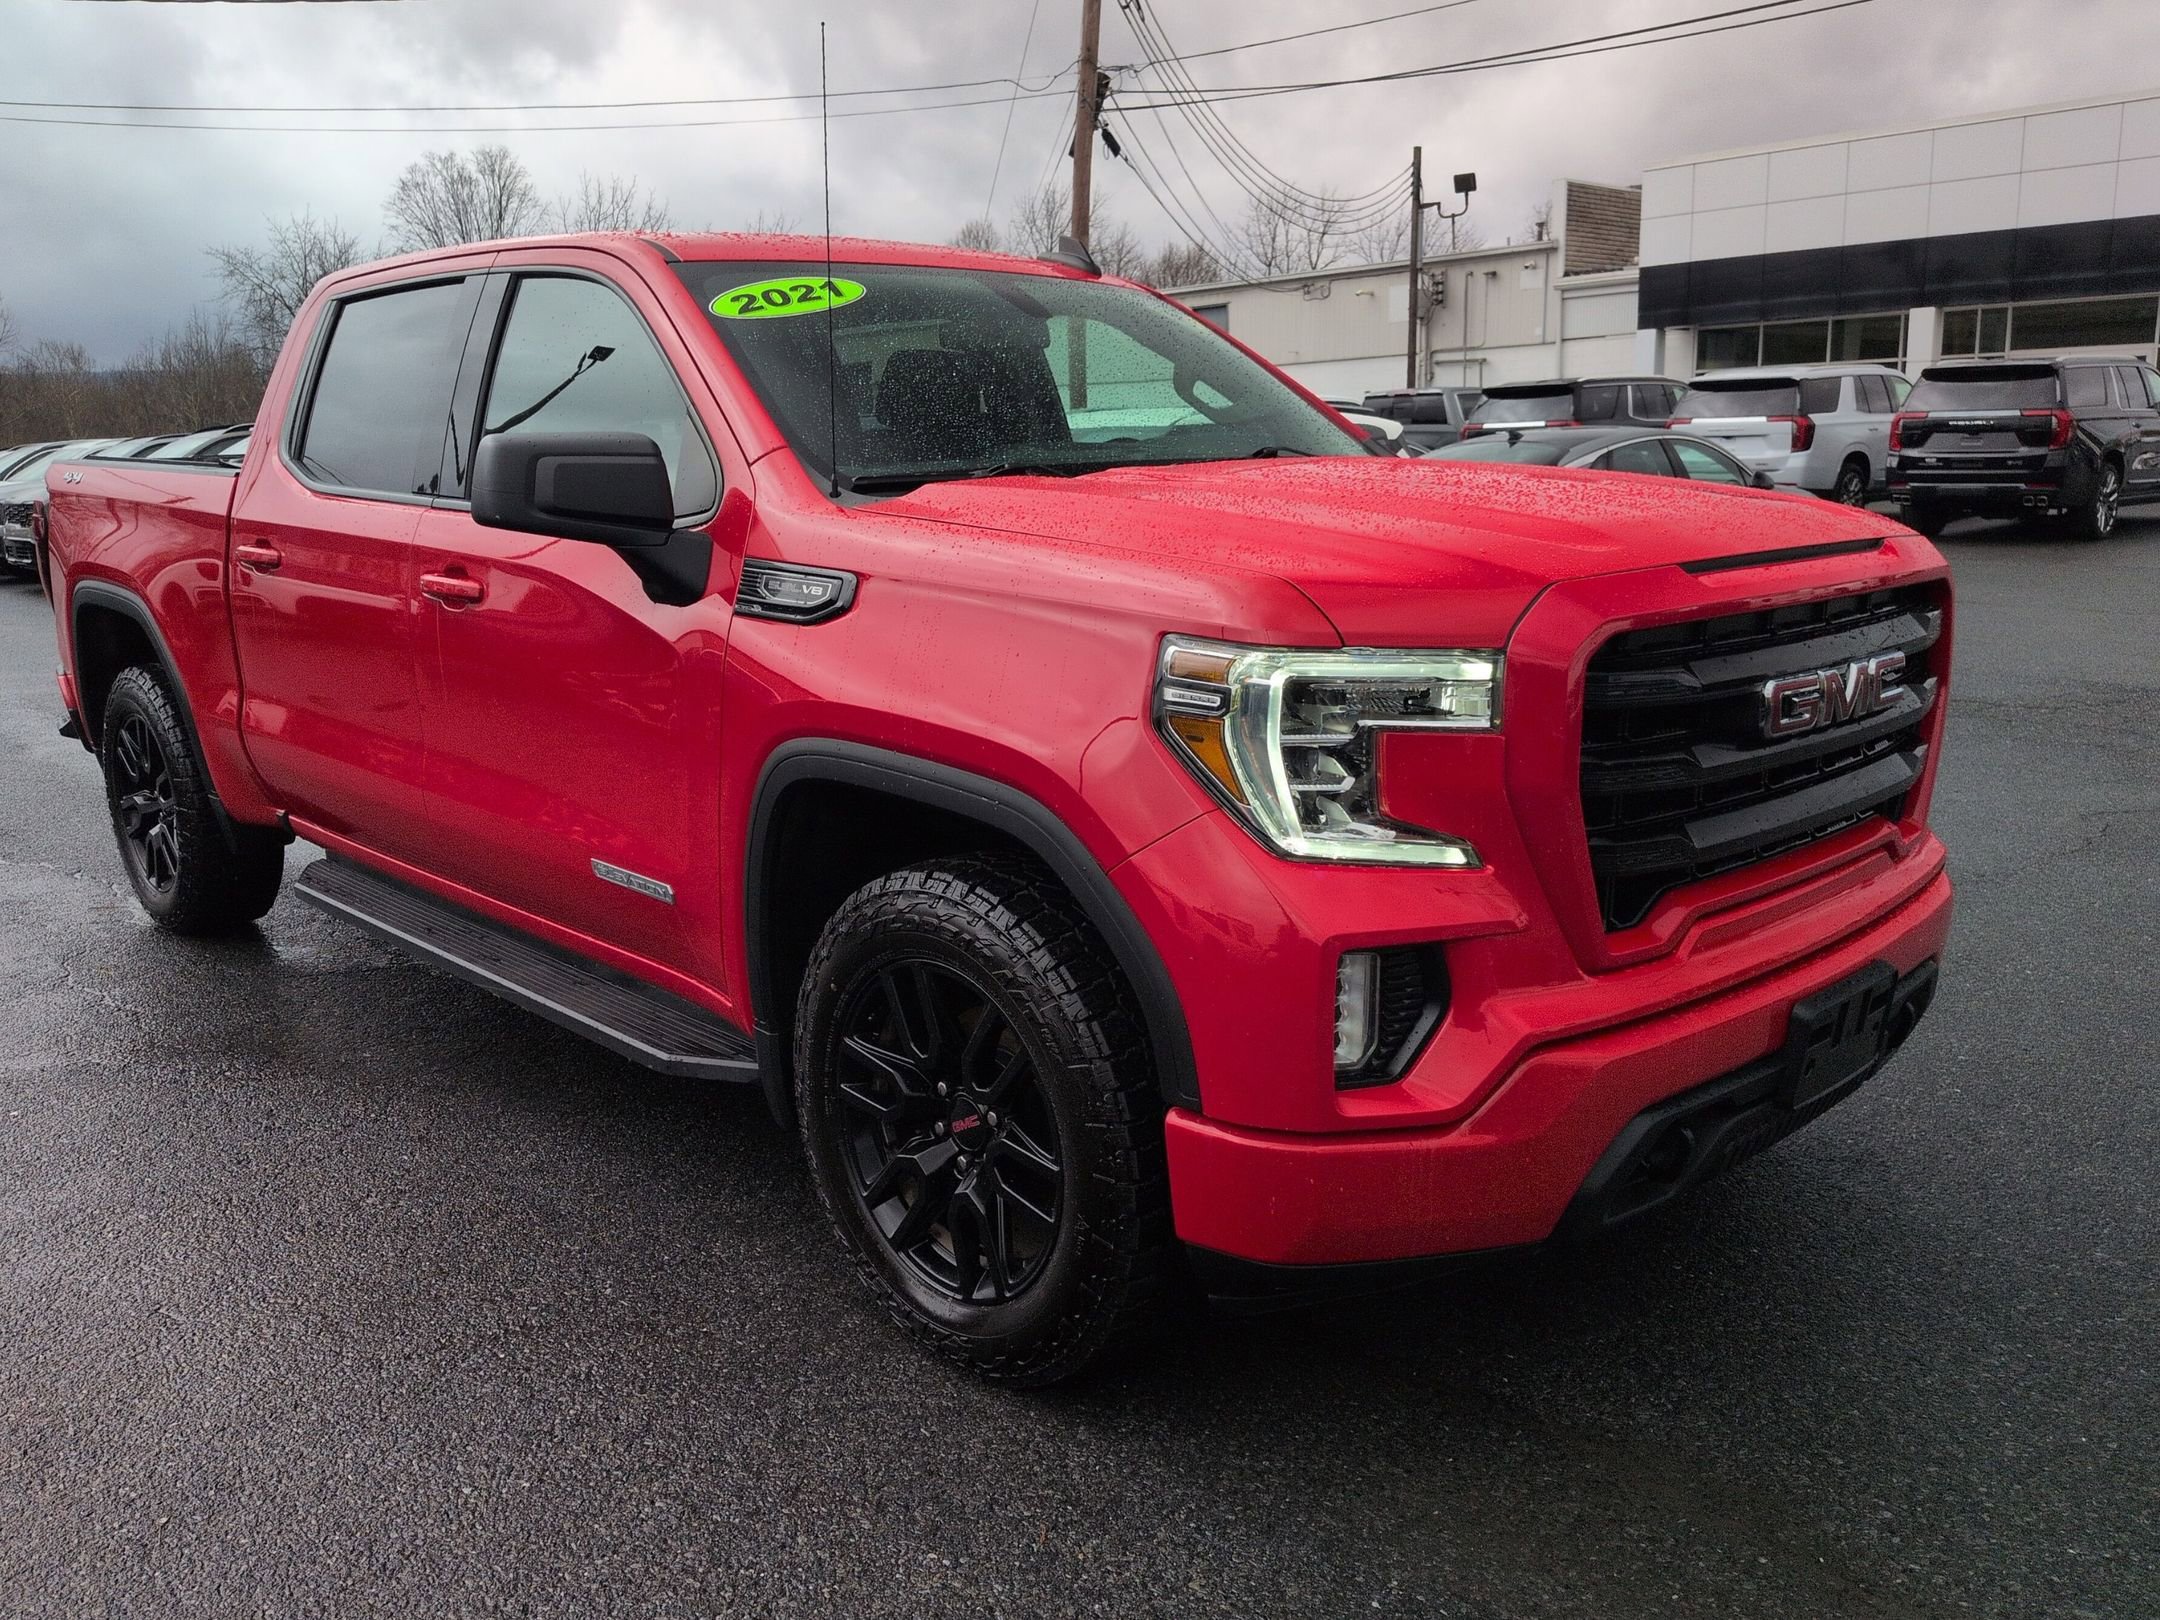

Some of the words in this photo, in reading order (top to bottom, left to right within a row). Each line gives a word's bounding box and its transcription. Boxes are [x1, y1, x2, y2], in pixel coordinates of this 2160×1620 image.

[730, 281, 846, 315] 2021
[801, 584, 823, 596] V8
[1762, 650, 1906, 737] GMC
[951, 1114, 981, 1133] GMC
